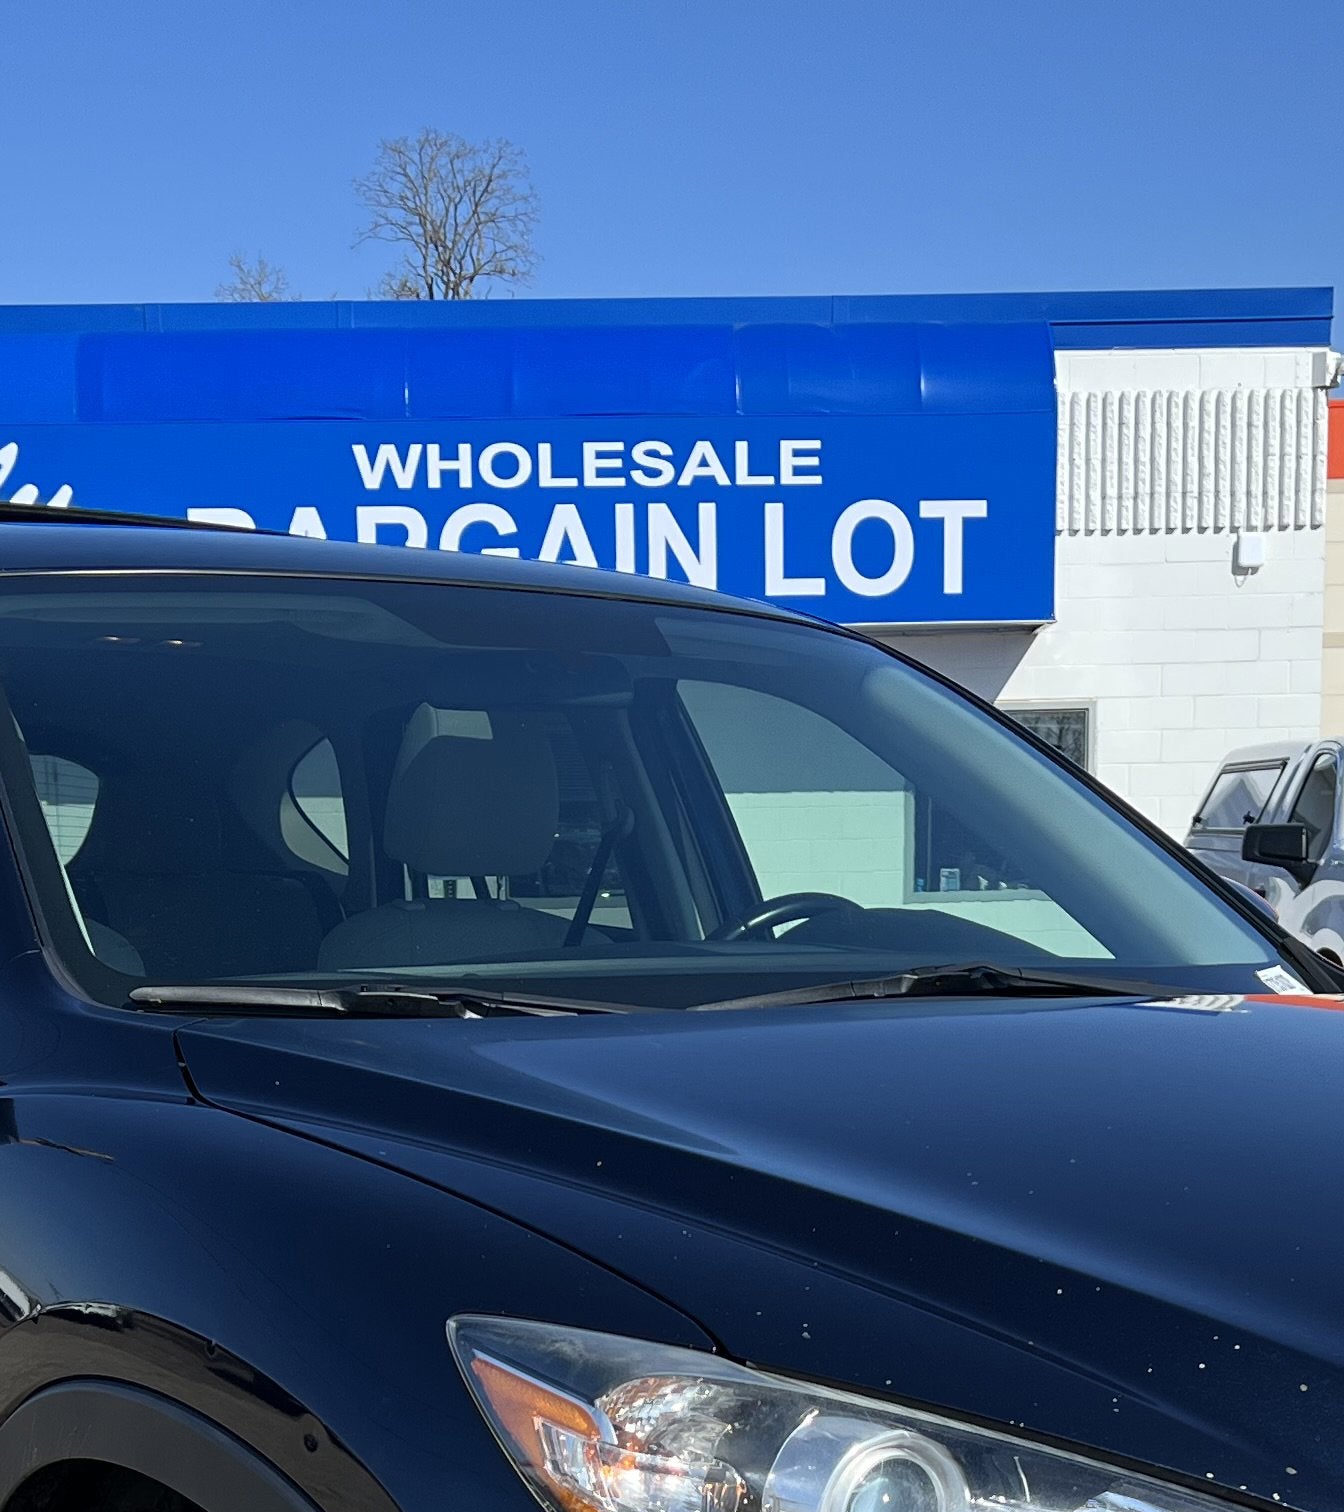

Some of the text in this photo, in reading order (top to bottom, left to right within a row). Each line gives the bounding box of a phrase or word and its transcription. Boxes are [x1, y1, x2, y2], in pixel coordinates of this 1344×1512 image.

[351, 440, 823, 489] WHOLESALE
[186, 499, 988, 596] GAIN LOT
